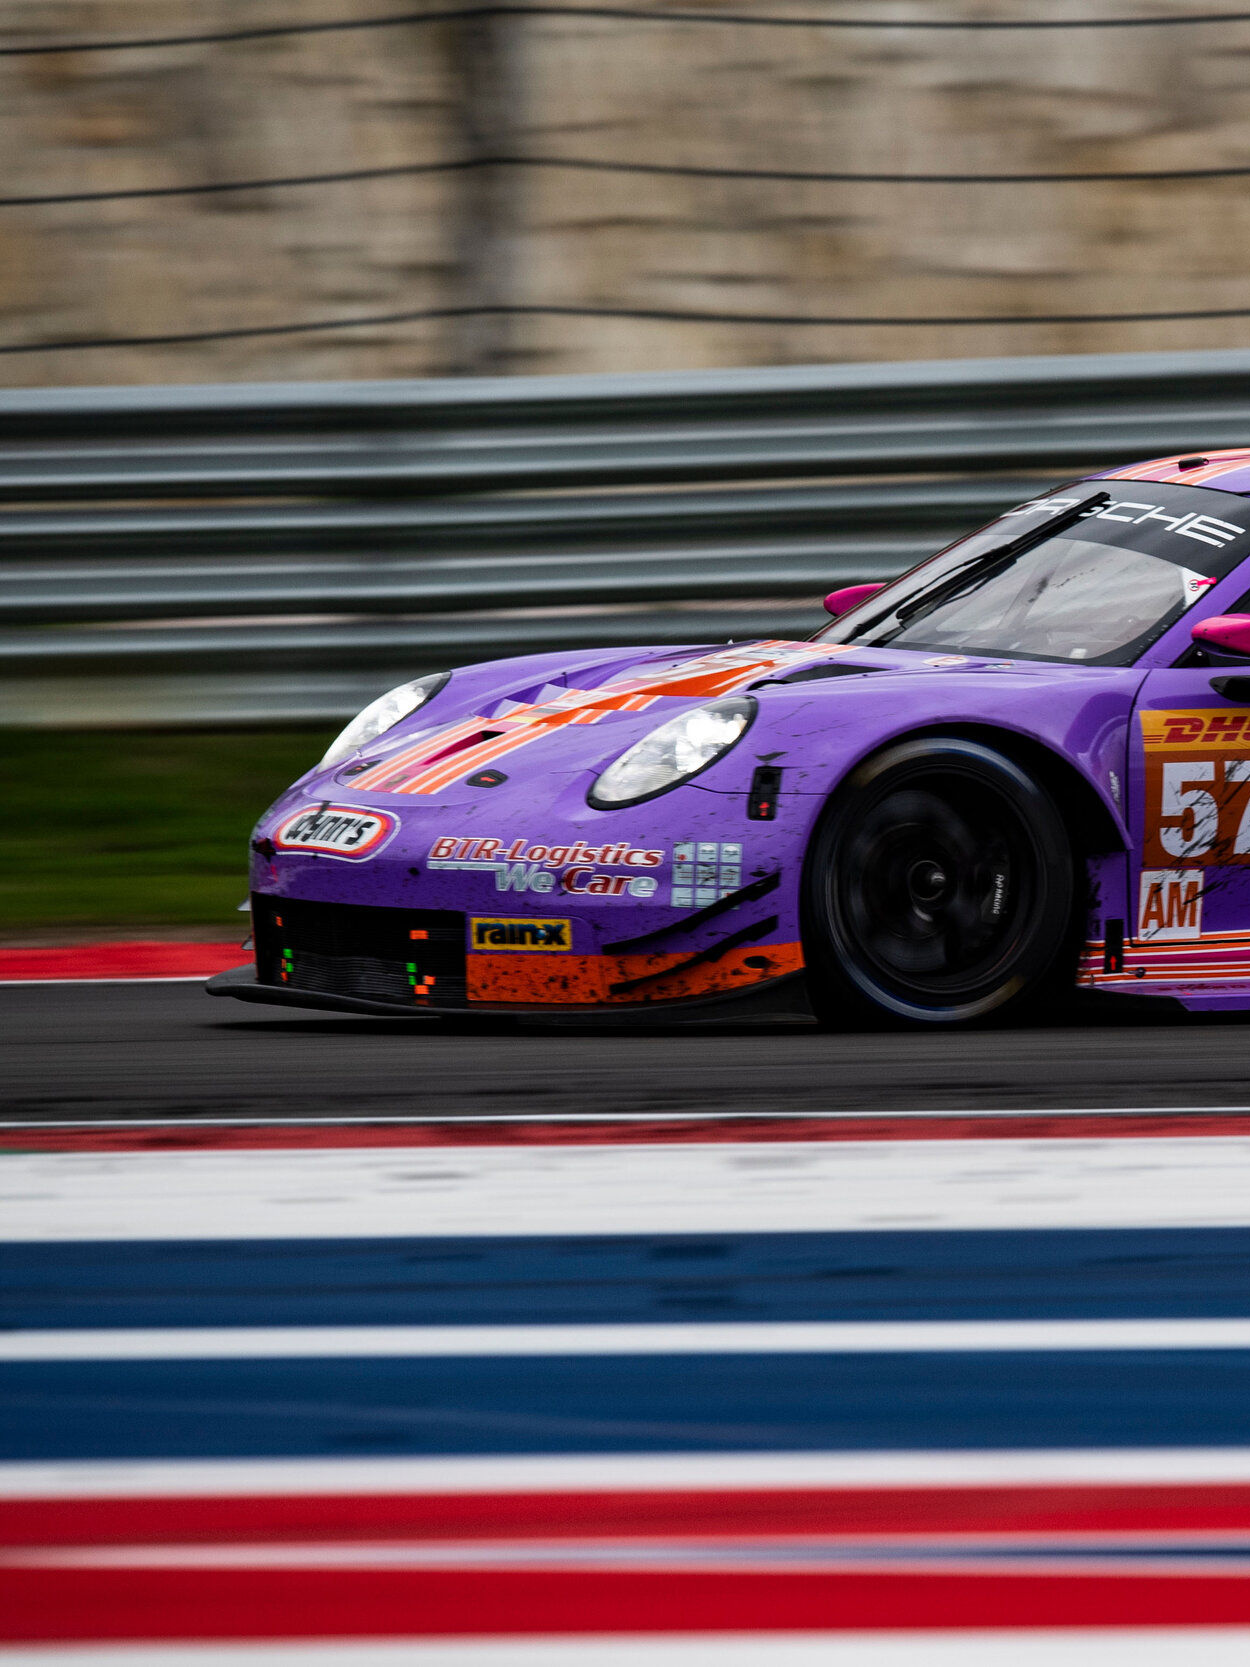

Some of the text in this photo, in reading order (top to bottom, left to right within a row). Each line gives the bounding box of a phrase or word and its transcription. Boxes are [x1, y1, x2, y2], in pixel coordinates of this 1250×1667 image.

[427, 836, 665, 869] BTR-Logistics
[495, 863, 556, 893] We
[561, 865, 659, 898] Care
[1141, 880, 1200, 930] AM
